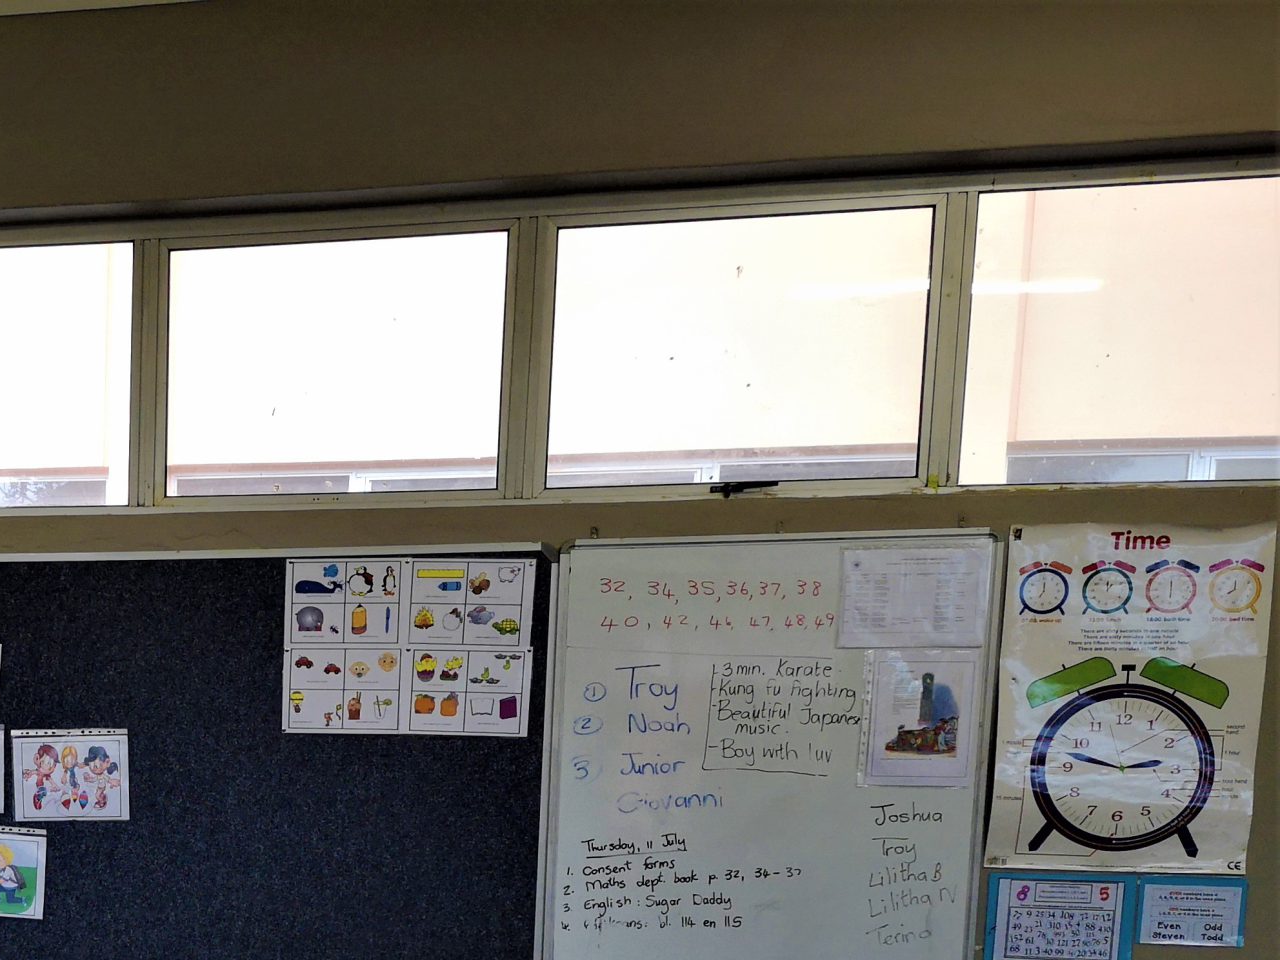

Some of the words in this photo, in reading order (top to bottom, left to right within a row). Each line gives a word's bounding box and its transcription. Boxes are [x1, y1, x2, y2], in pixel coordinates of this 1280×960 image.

[1110, 530, 1171, 550] Time
[797, 580, 821, 597] 38
[814, 612, 835, 630] 49
[776, 658, 833, 678] Karate
[615, 664, 678, 711] Troy
[719, 678, 755, 704] Kung
[766, 679, 781, 696] fu
[791, 679, 856, 713] fighting
[717, 698, 791, 721] Beautiful
[628, 712, 691, 734] Noah
[1088, 722, 1103, 732] 11
[1115, 714, 1133, 725] 12
[1147, 719, 1154, 730] 1
[1072, 738, 1090, 748] 10
[1163, 738, 1175, 749] 2
[720, 738, 756, 767] Boy
[763, 741, 798, 761] with
[809, 742, 833, 763] luv
[620, 752, 686, 775] Junior
[1062, 761, 1074, 773] 9
[1170, 764, 1181, 775] 3
[616, 786, 723, 814] Giovanni
[1069, 787, 1080, 798] 8
[1160, 788, 1172, 799] 4
[870, 801, 943, 826] Joshua
[1087, 805, 1098, 816] 7
[1111, 811, 1124, 822] 6
[1140, 806, 1151, 817] 5
[660, 833, 688, 852] July
[871, 837, 917, 865] Troy
[582, 860, 632, 877] Consent
[643, 856, 676, 871] forms
[585, 877, 626, 892] Maths
[673, 869, 699, 884] book
[1016, 885, 1030, 901] 8
[1099, 886, 1110, 901] 5
[645, 895, 682, 915] Sugar
[693, 892, 733, 910] Daddy
[702, 919, 716, 928] en
[1157, 921, 1181, 930] Even
[1204, 923, 1223, 931] Odd
[1152, 931, 1185, 940] Steven
[1200, 933, 1224, 941] Todd
